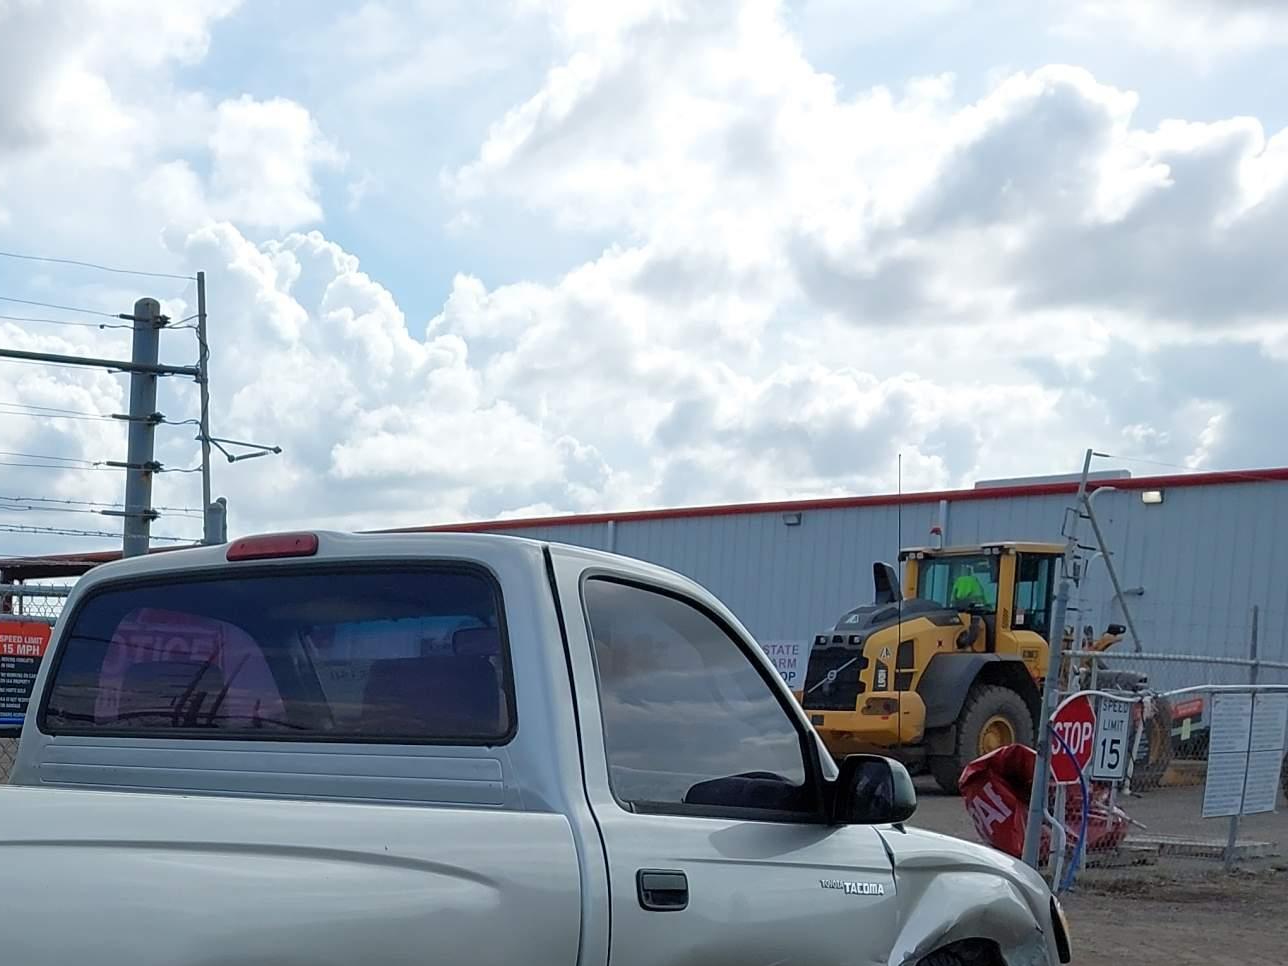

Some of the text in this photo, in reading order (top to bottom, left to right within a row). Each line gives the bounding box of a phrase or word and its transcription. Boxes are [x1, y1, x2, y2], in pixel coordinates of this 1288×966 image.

[0, 634, 43, 645] SPEED LIMIT
[3, 643, 40, 655] 15 MPH
[763, 644, 800, 656] STATE
[772, 658, 797, 669] ARM
[779, 671, 796, 682] OP
[1103, 700, 1128, 714] SPEED
[1103, 719, 1124, 731] LIMIT
[1051, 721, 1093, 755] STOP
[1100, 737, 1121, 770] 15
[843, 882, 885, 896] TACOMA
